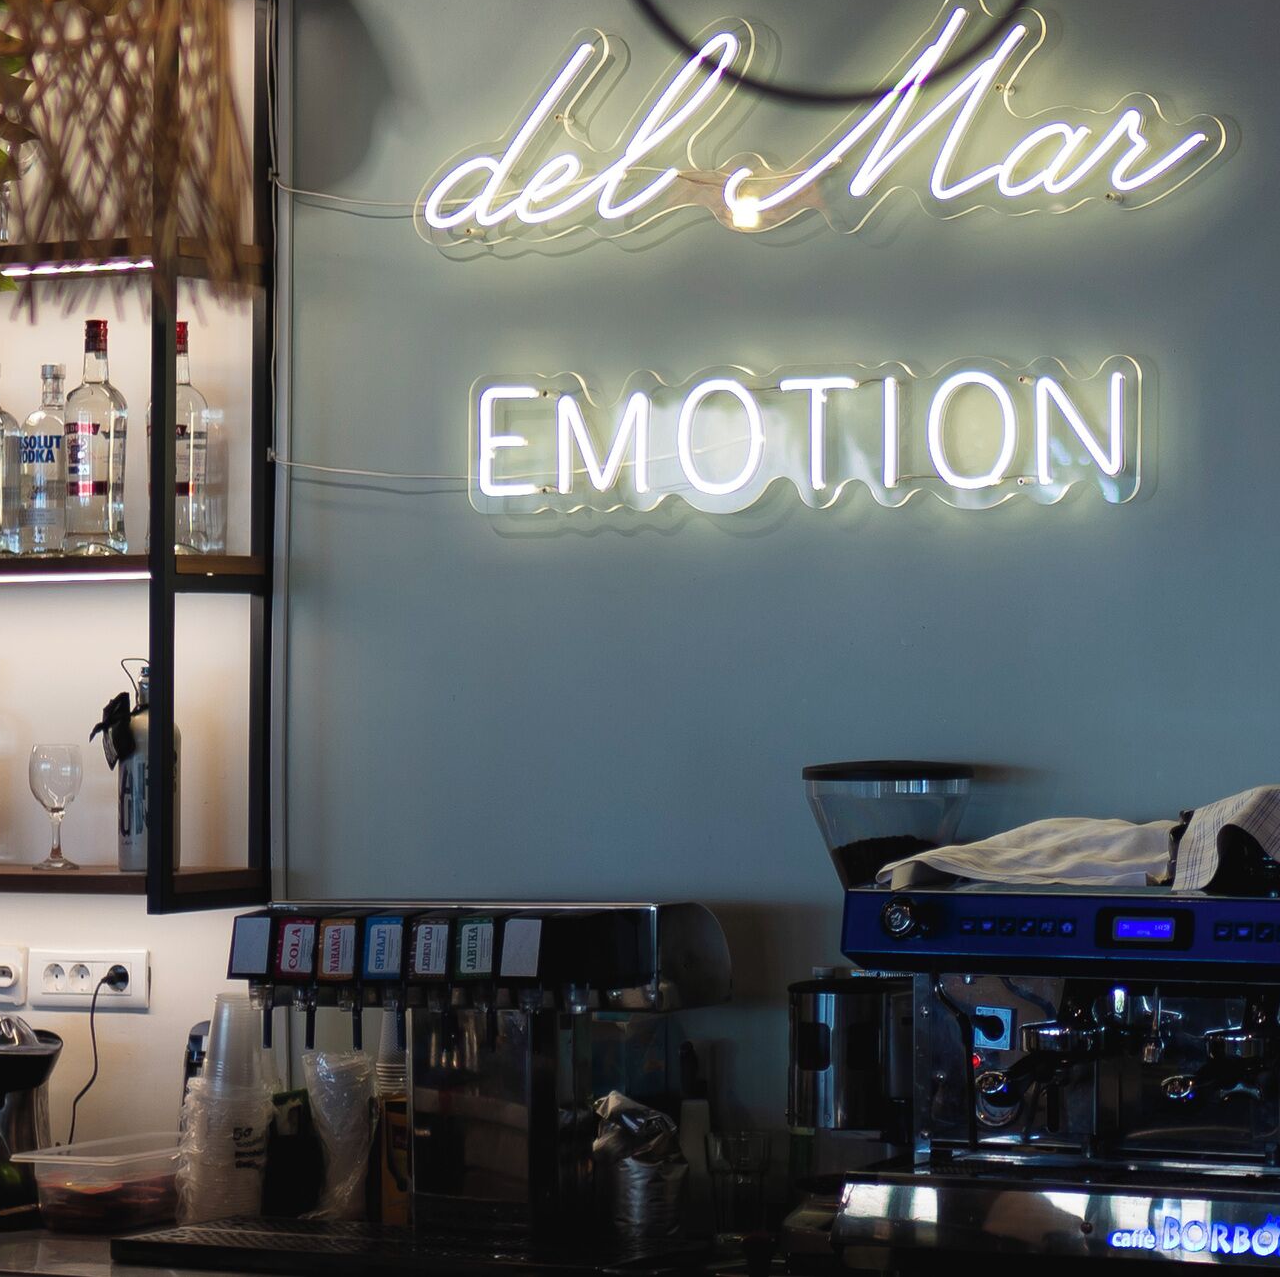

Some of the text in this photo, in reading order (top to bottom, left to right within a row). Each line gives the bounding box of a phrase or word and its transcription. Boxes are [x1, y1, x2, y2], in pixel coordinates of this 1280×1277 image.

[425, 6, 1208, 230] del Mar
[478, 371, 1127, 495] EMOTION
[288, 927, 302, 970] COLA
[375, 928, 387, 970] SPRAJT
[466, 926, 478, 970] JABUKA
